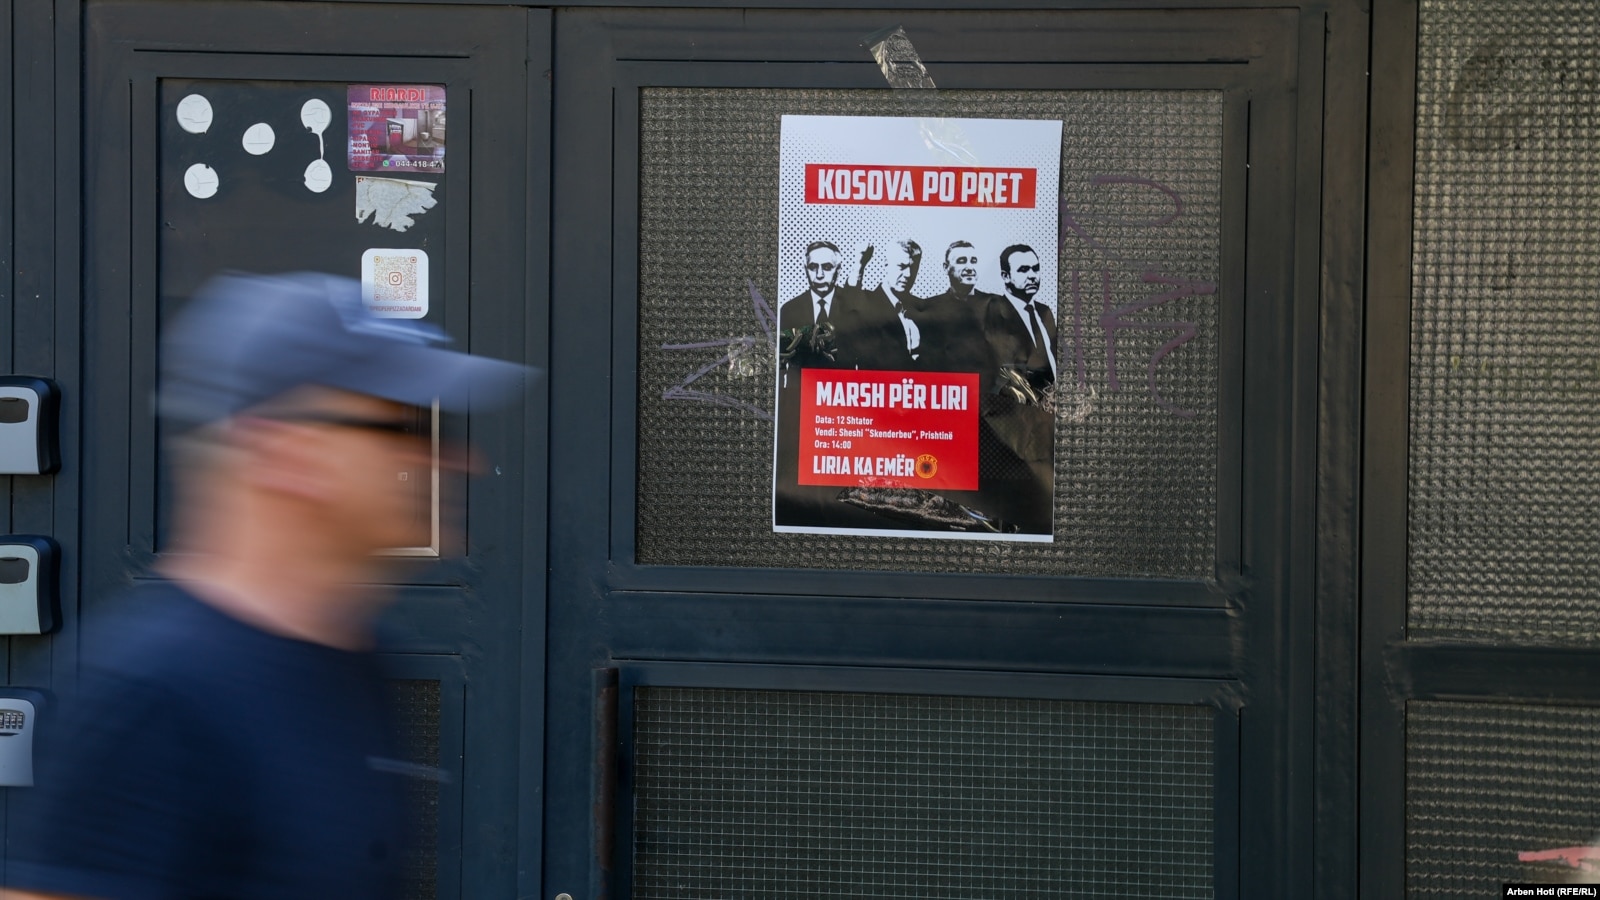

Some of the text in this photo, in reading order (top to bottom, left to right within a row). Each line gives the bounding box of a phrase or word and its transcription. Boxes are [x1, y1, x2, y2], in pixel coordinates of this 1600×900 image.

[370, 87, 426, 102] RIARDI
[817, 168, 1024, 204] KOSOVA PO PRET
[815, 378, 968, 411] MARSH PËR LIRI
[815, 415, 874, 426] Data: 12 Shtator
[815, 427, 838, 437] Vendi:
[838, 428, 864, 438] Sheshi
[920, 430, 954, 441] Prishtinë
[814, 440, 852, 450] Ora: 14:00
[813, 453, 915, 478] LIRIA KA EMËR
